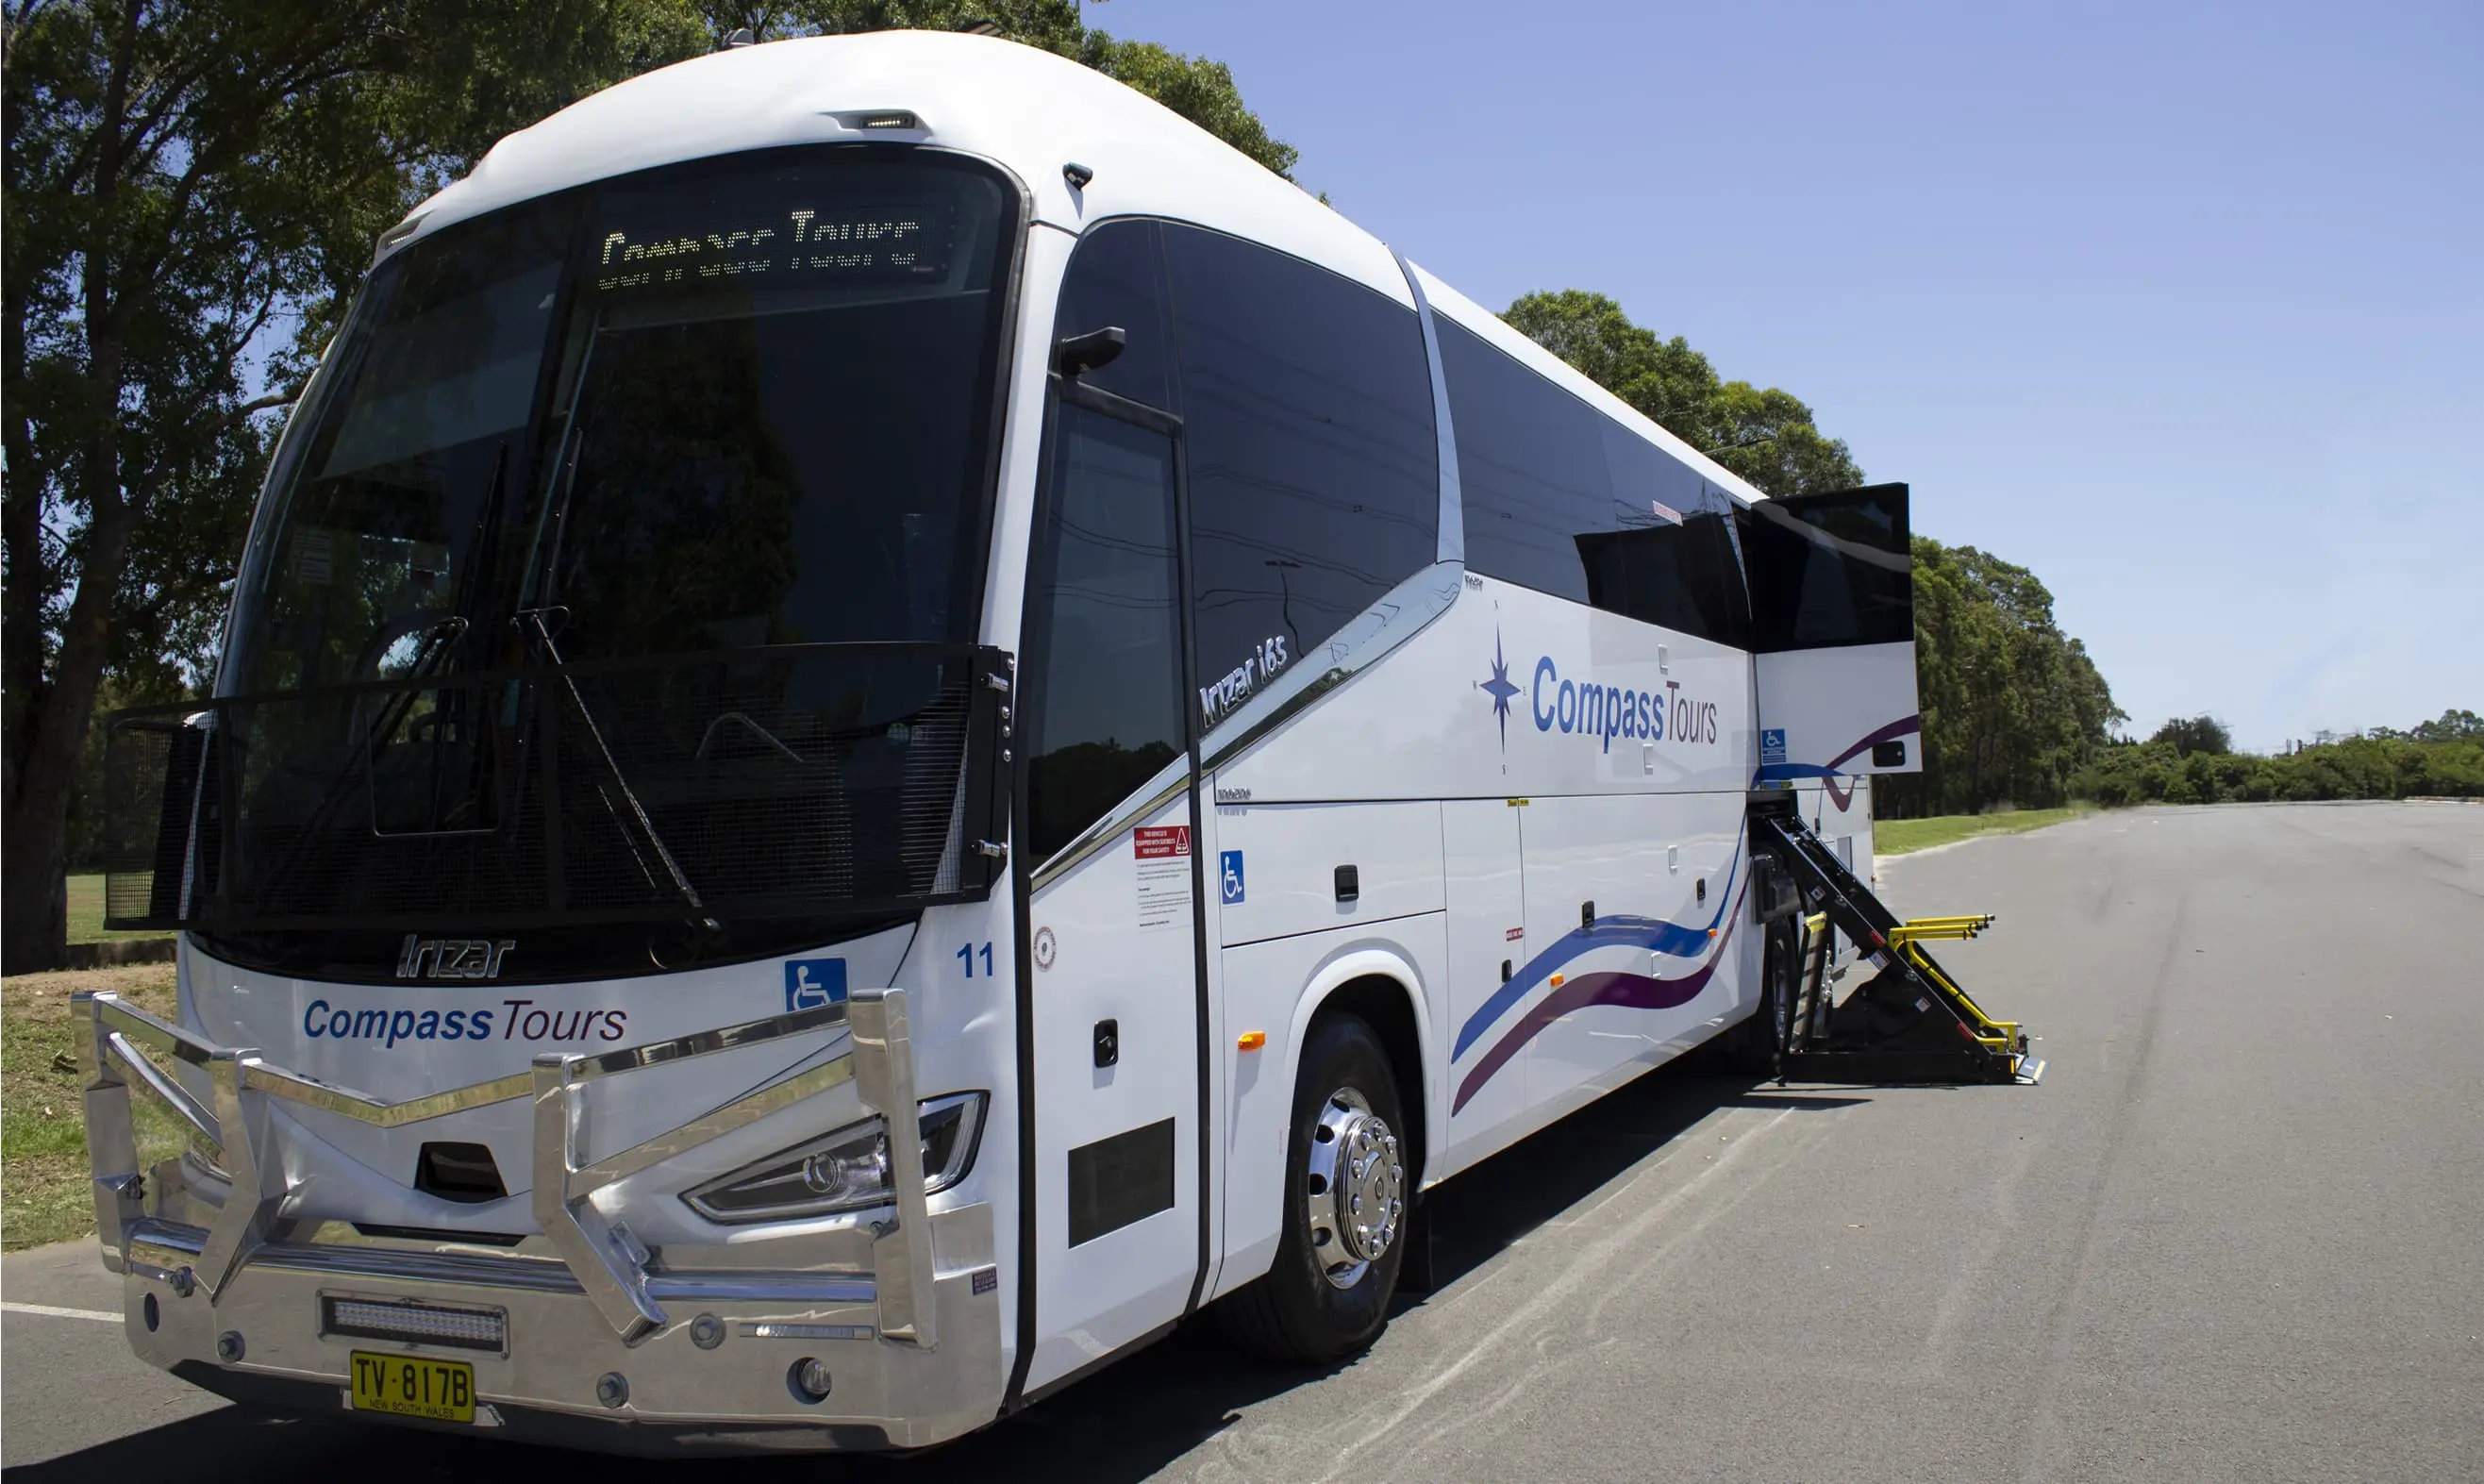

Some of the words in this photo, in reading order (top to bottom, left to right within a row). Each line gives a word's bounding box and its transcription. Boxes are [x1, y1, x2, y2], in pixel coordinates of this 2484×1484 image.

[1199, 658, 1255, 729] Irizar
[1256, 635, 1288, 684] i65
[1533, 656, 1664, 755] Compass
[1666, 680, 1717, 745] Tours
[396, 933, 516, 978] Irizar
[957, 942, 992, 977] 11
[304, 999, 494, 1049] Compass
[503, 1000, 628, 1042] Tours
[369, 1398, 389, 1410] NEW
[392, 1402, 422, 1414] SOUTH
[425, 1406, 456, 1419] WALES
